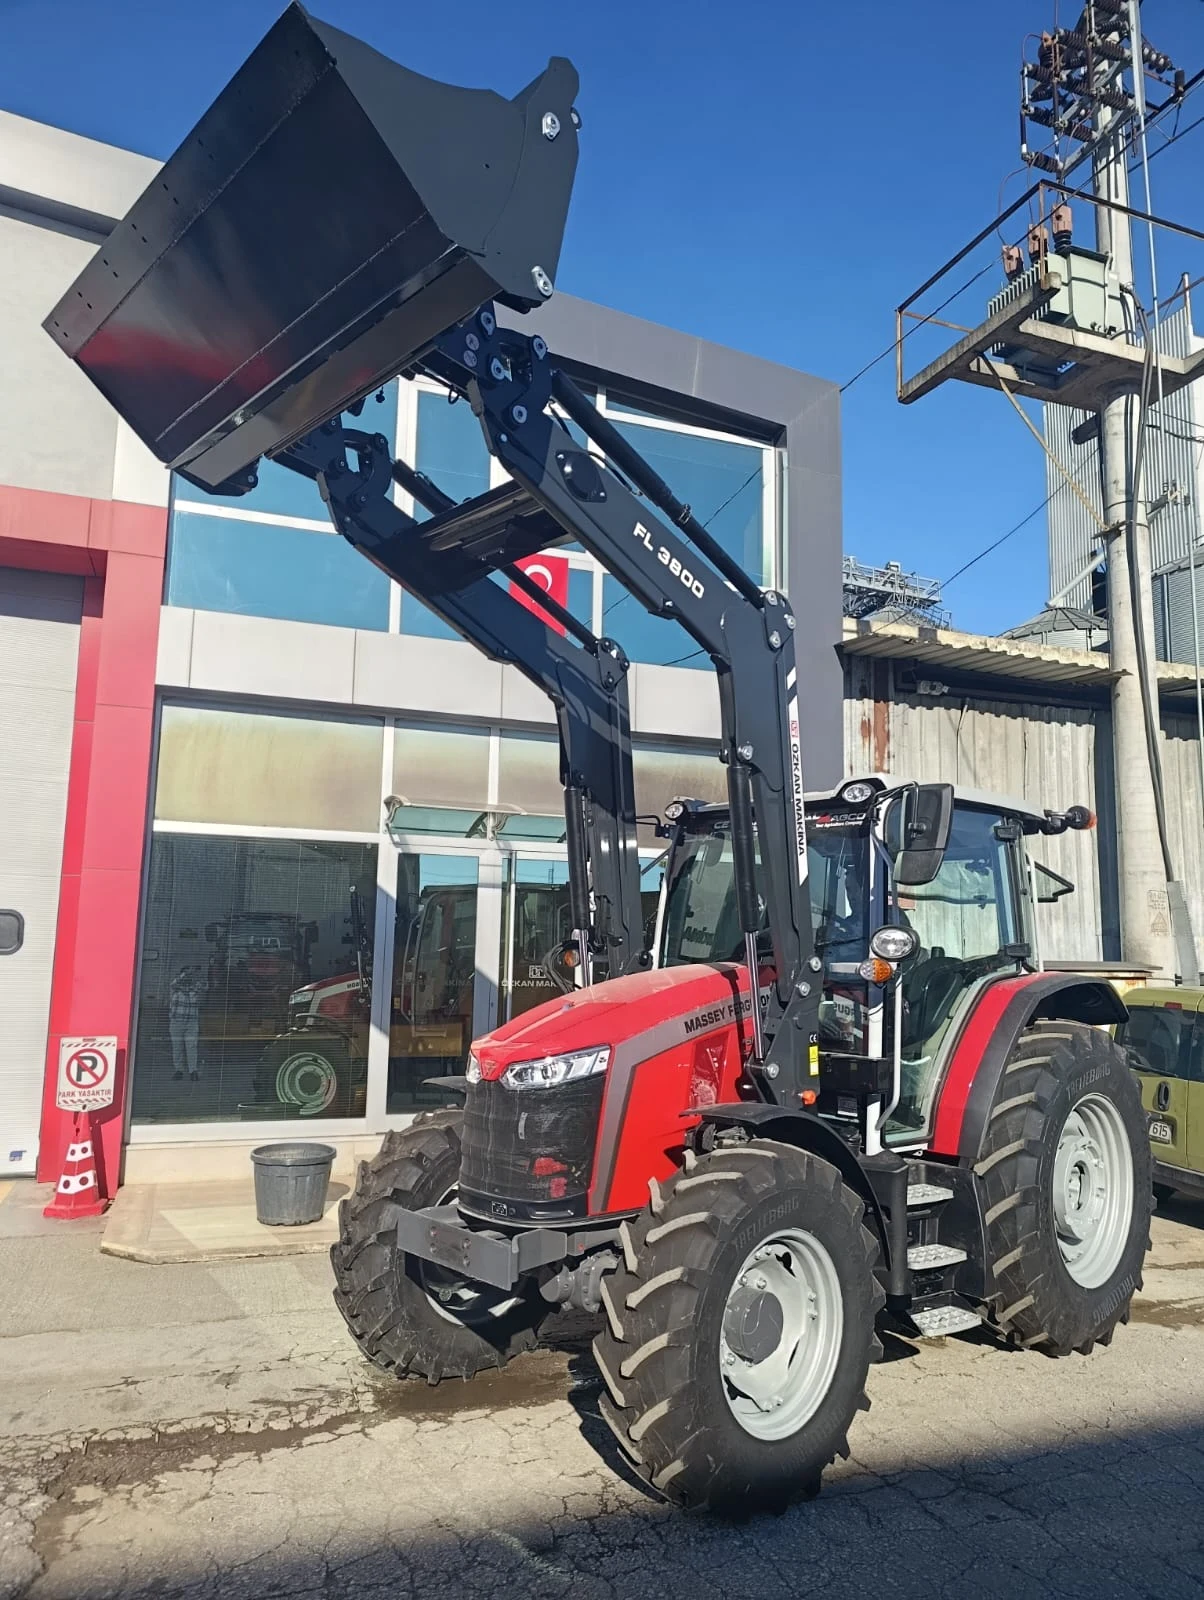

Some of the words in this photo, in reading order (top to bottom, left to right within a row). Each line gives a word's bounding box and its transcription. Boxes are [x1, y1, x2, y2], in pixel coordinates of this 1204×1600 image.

[633, 521, 654, 552] FL
[657, 546, 705, 599] 3800
[684, 1006, 725, 1034] MASSEY
[727, 994, 770, 1017] FERGO
[76, 1055, 98, 1082] P
[78, 1088, 112, 1097] YASAKTIR
[1152, 1123, 1168, 1137] 615
